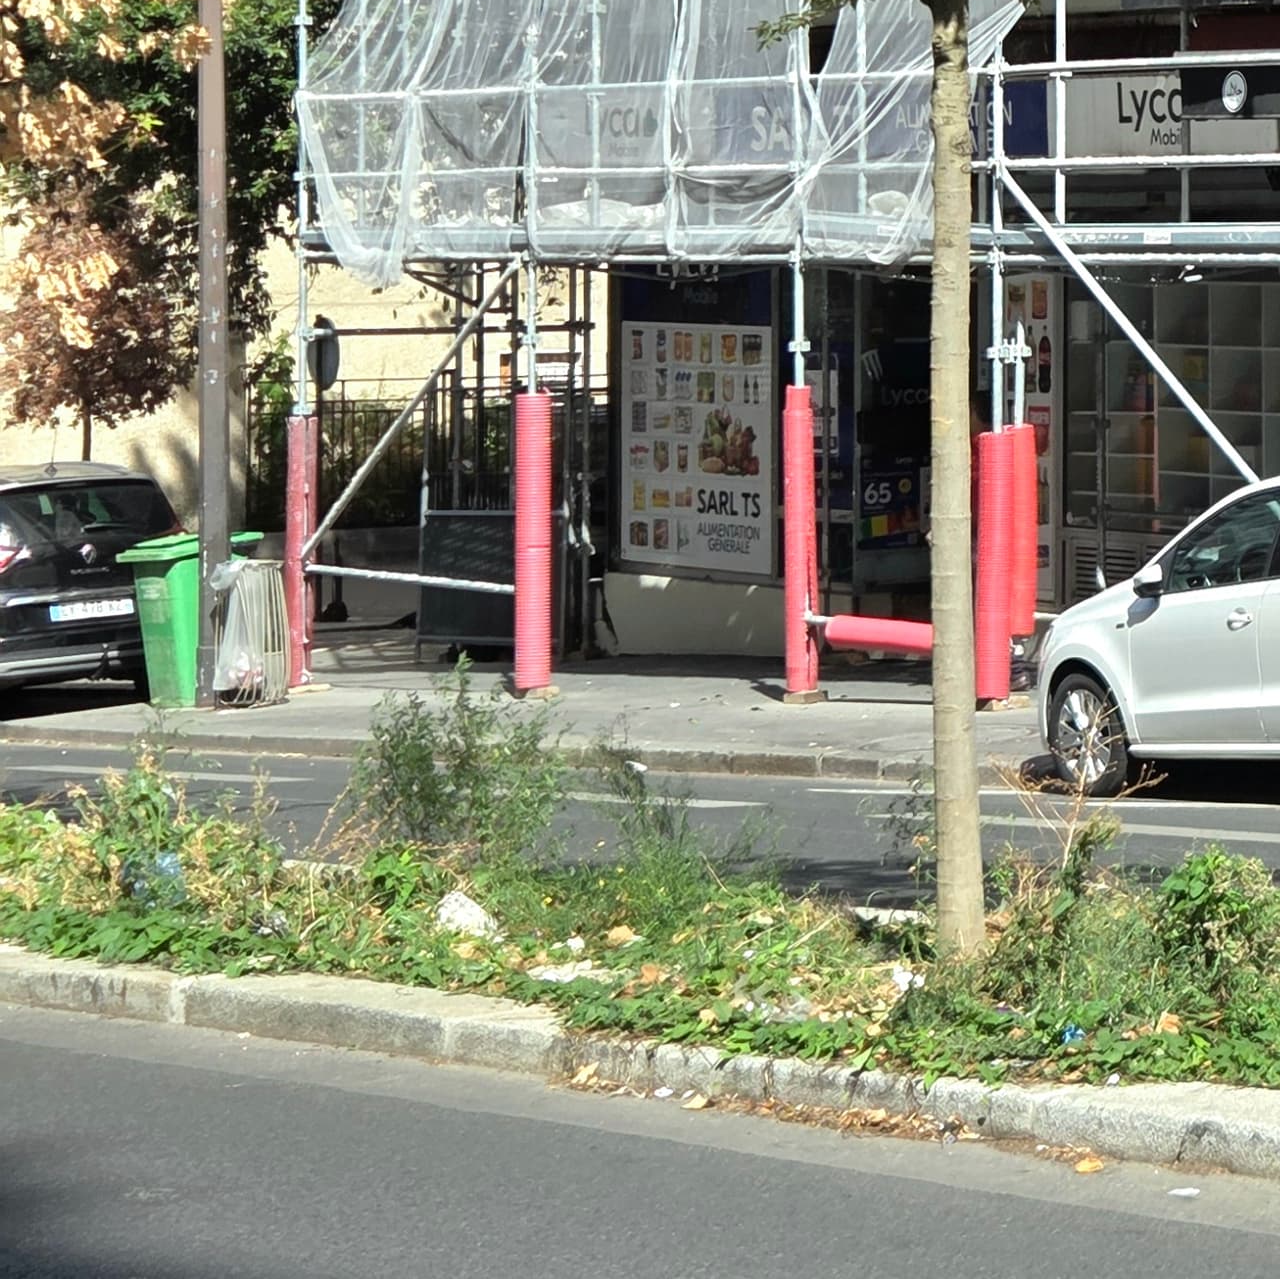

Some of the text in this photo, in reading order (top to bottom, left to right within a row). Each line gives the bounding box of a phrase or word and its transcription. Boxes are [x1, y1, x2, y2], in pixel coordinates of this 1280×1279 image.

[1150, 127, 1182, 146] Mobi
[697, 488, 761, 519] SARL TS
[864, 482, 893, 505] 65
[696, 520, 761, 541] ALIMENTATION
[707, 537, 751, 554] GENERALE
